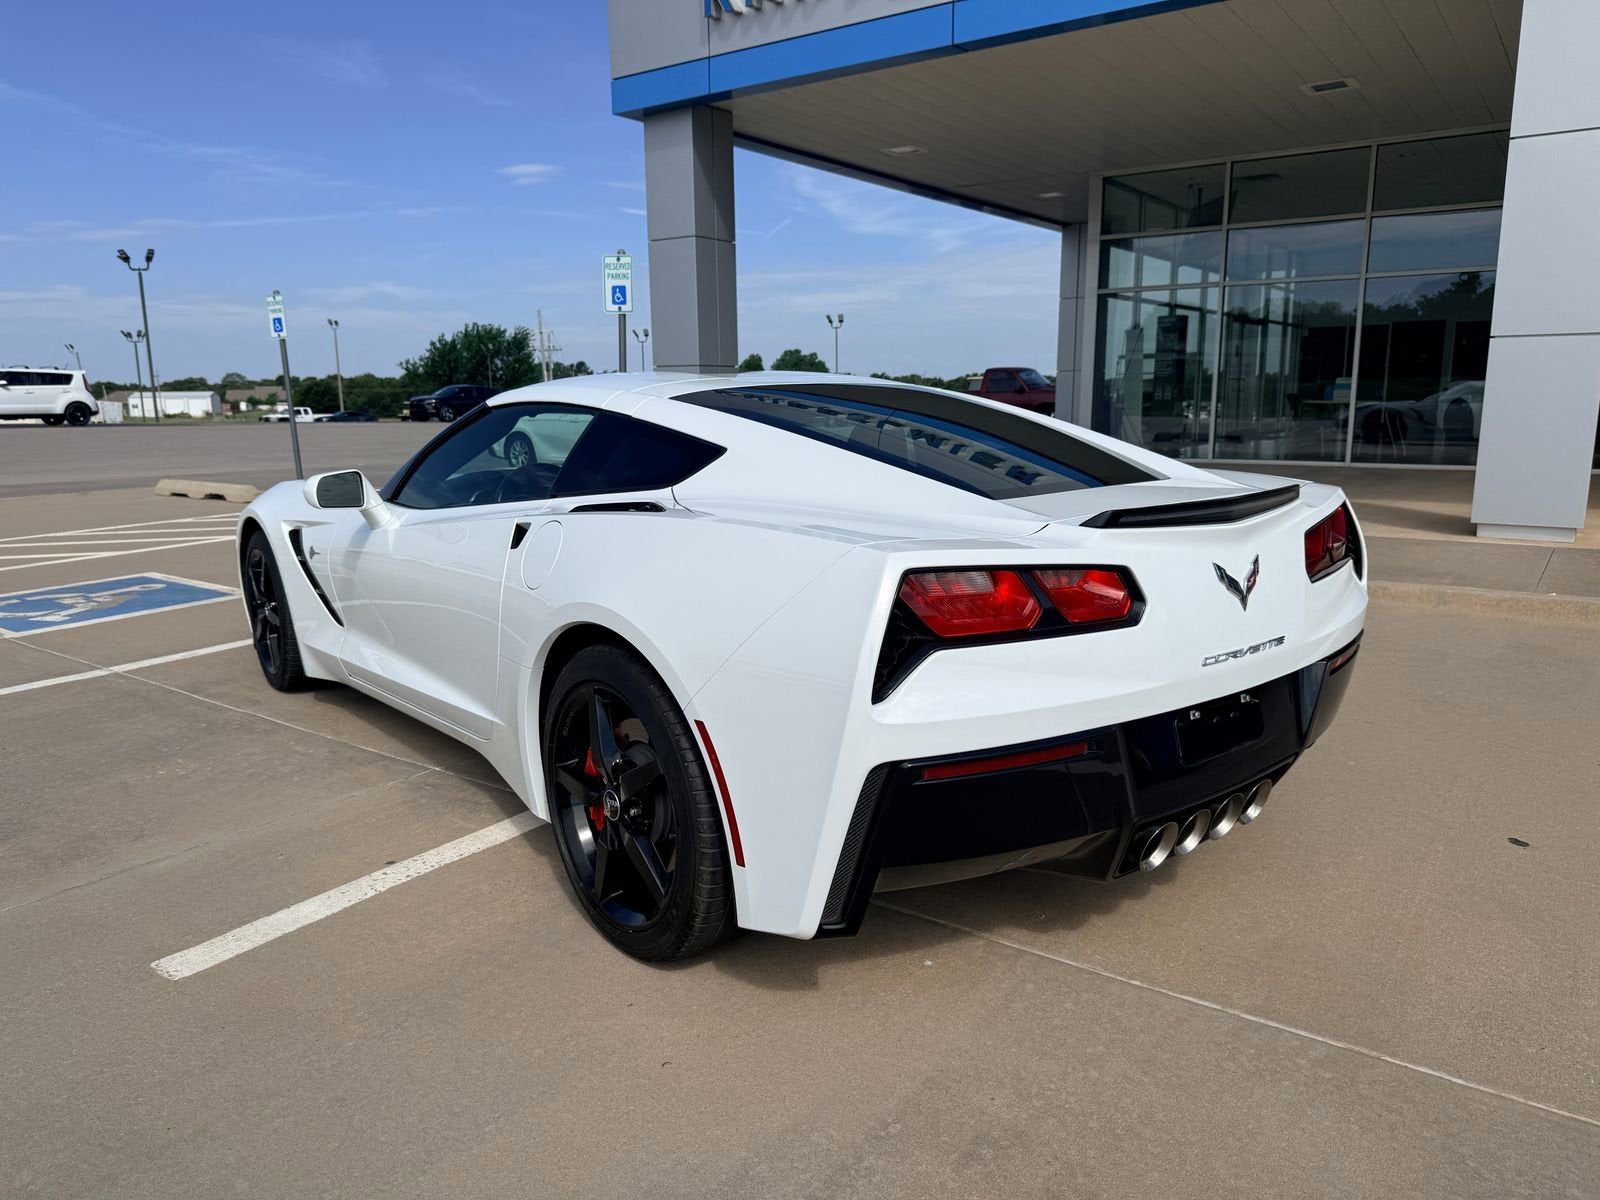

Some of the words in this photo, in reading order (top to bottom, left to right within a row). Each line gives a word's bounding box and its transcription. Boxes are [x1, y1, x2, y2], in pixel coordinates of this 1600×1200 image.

[605, 262, 631, 271] RESERVED
[607, 272, 630, 280] PARKING
[1201, 635, 1286, 667] CORVETTE
